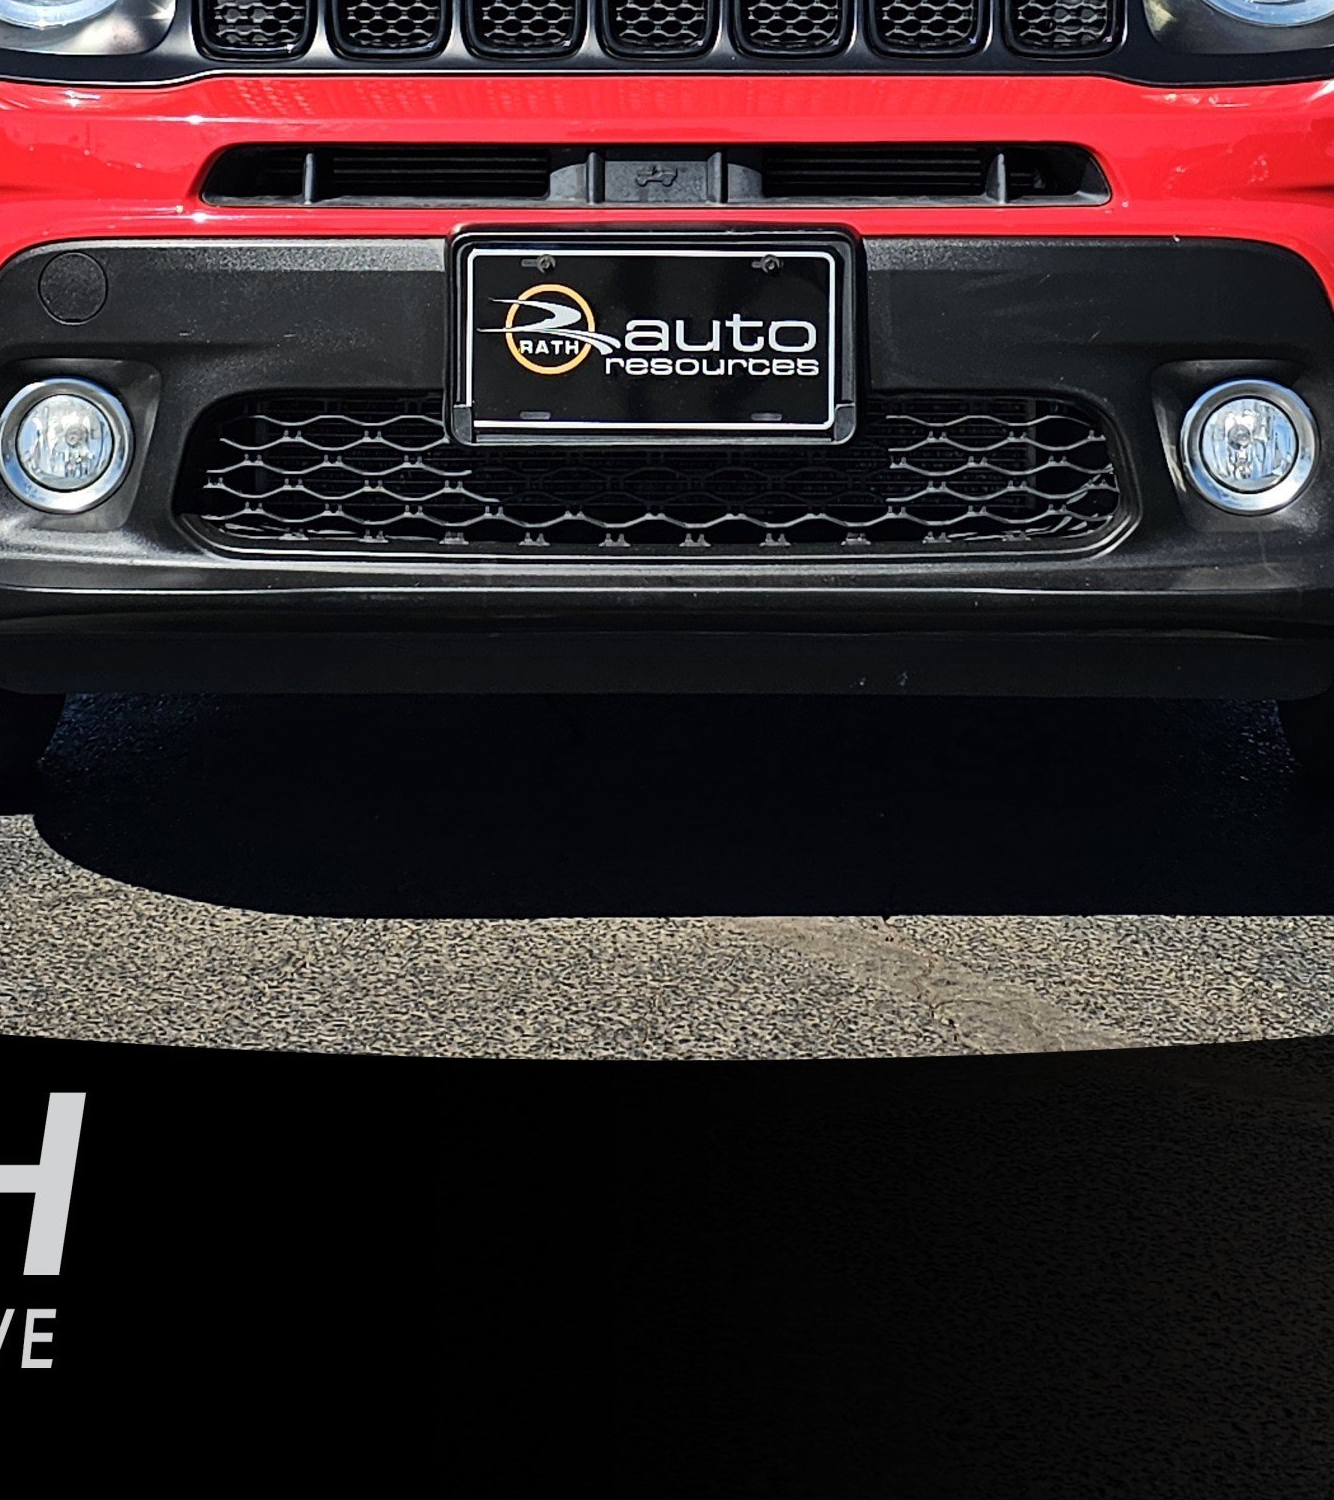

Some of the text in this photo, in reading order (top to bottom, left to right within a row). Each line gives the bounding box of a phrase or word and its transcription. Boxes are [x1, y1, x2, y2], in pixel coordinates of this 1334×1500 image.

[519, 313, 818, 355] RATH auto
[605, 357, 820, 376] resources
